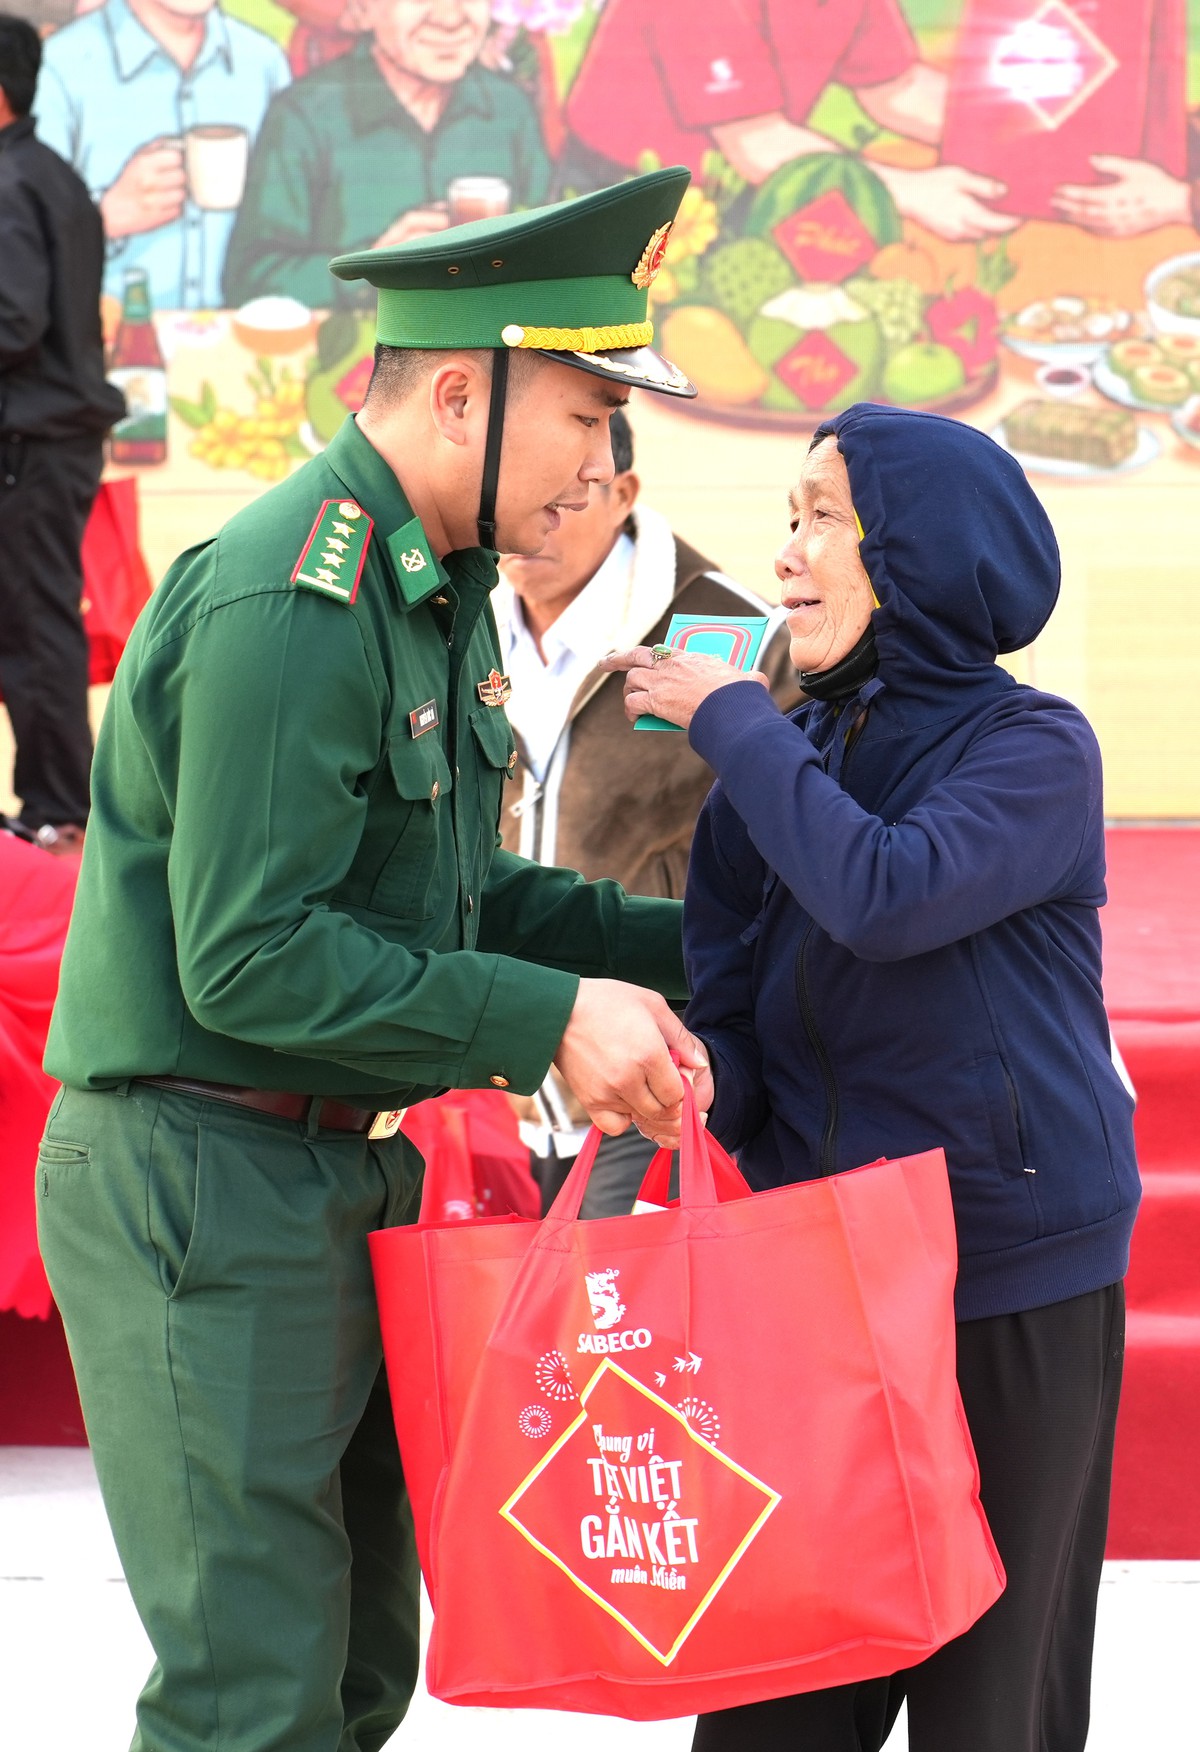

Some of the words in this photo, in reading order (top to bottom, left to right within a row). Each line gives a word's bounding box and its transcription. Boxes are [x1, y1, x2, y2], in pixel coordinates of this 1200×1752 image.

[576, 1328, 652, 1354] SABECO
[637, 1427, 655, 1455] vị
[620, 1454, 683, 1511] VIỆT
[580, 1495, 645, 1560] GẮN
[641, 1500, 699, 1566] KẾT
[610, 1564, 648, 1585] muôn
